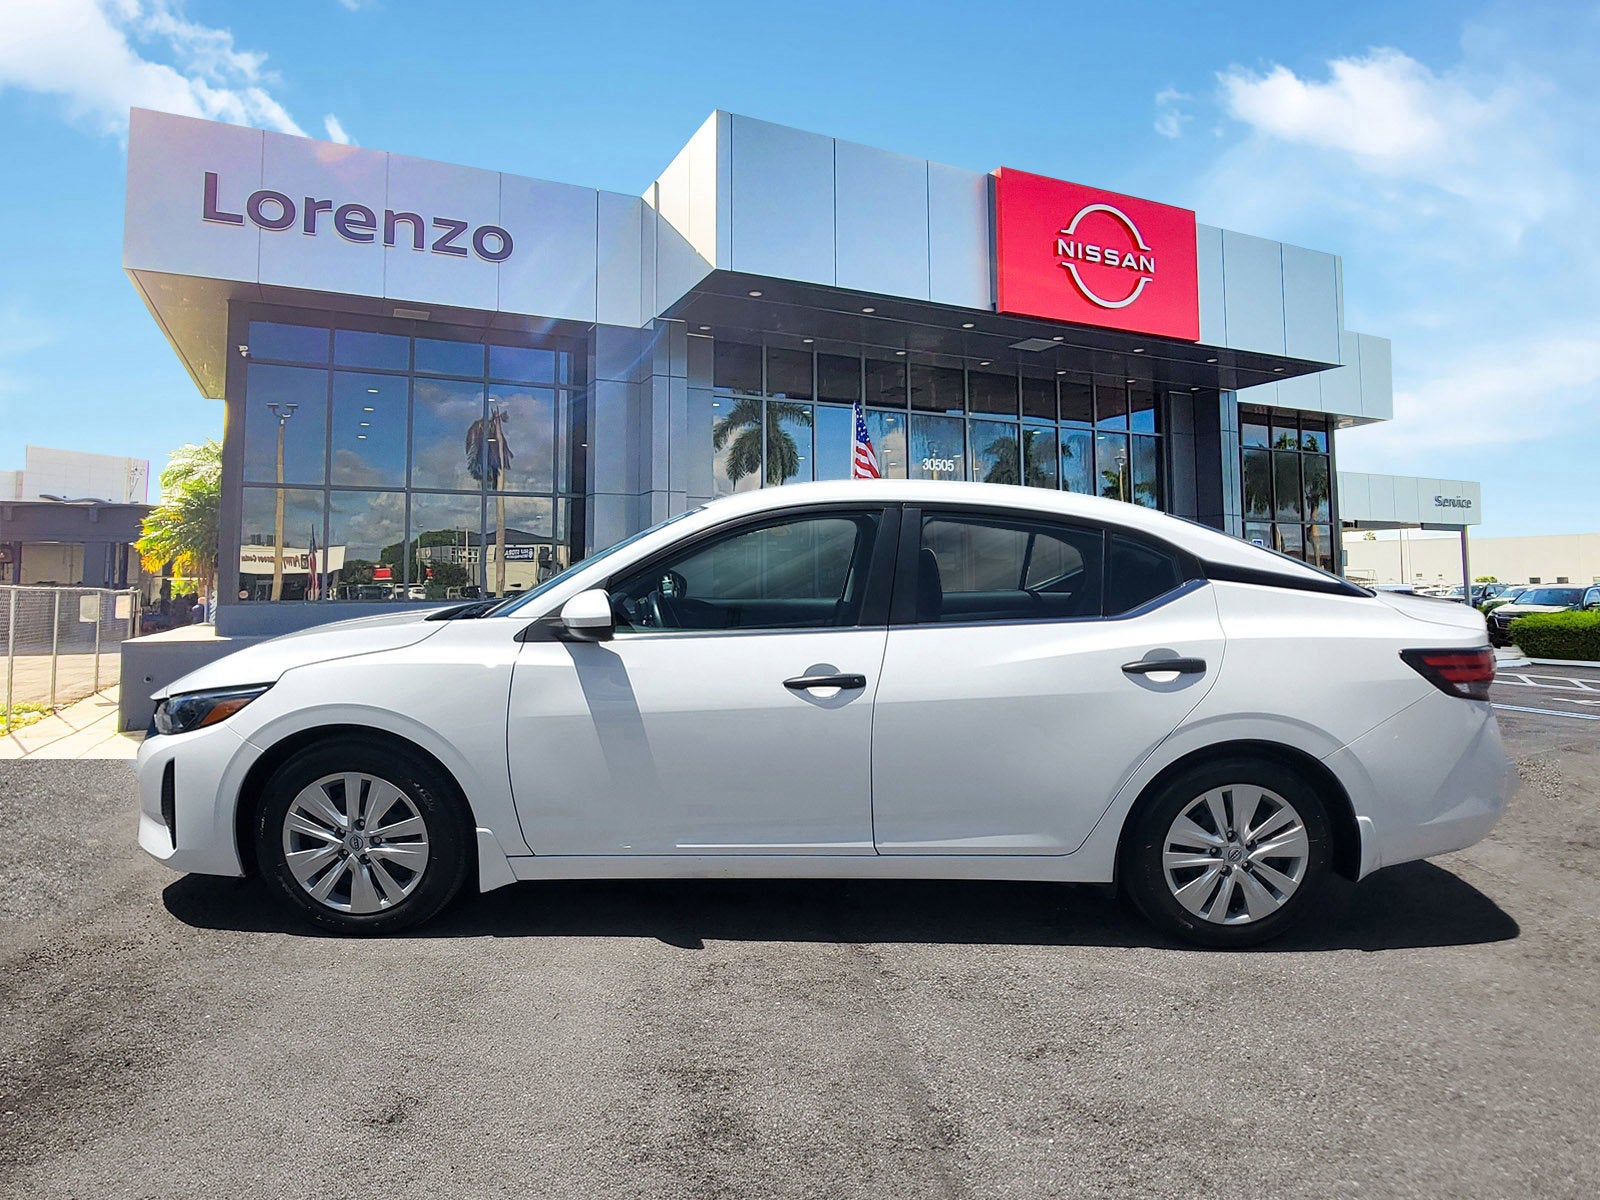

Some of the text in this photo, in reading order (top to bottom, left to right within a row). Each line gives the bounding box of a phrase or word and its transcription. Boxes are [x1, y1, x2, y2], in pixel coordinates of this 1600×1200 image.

[202, 171, 515, 263] Lorenzo
[1057, 238, 1155, 273] NISSAN
[922, 458, 954, 472] 30505
[1434, 495, 1472, 508] Service
